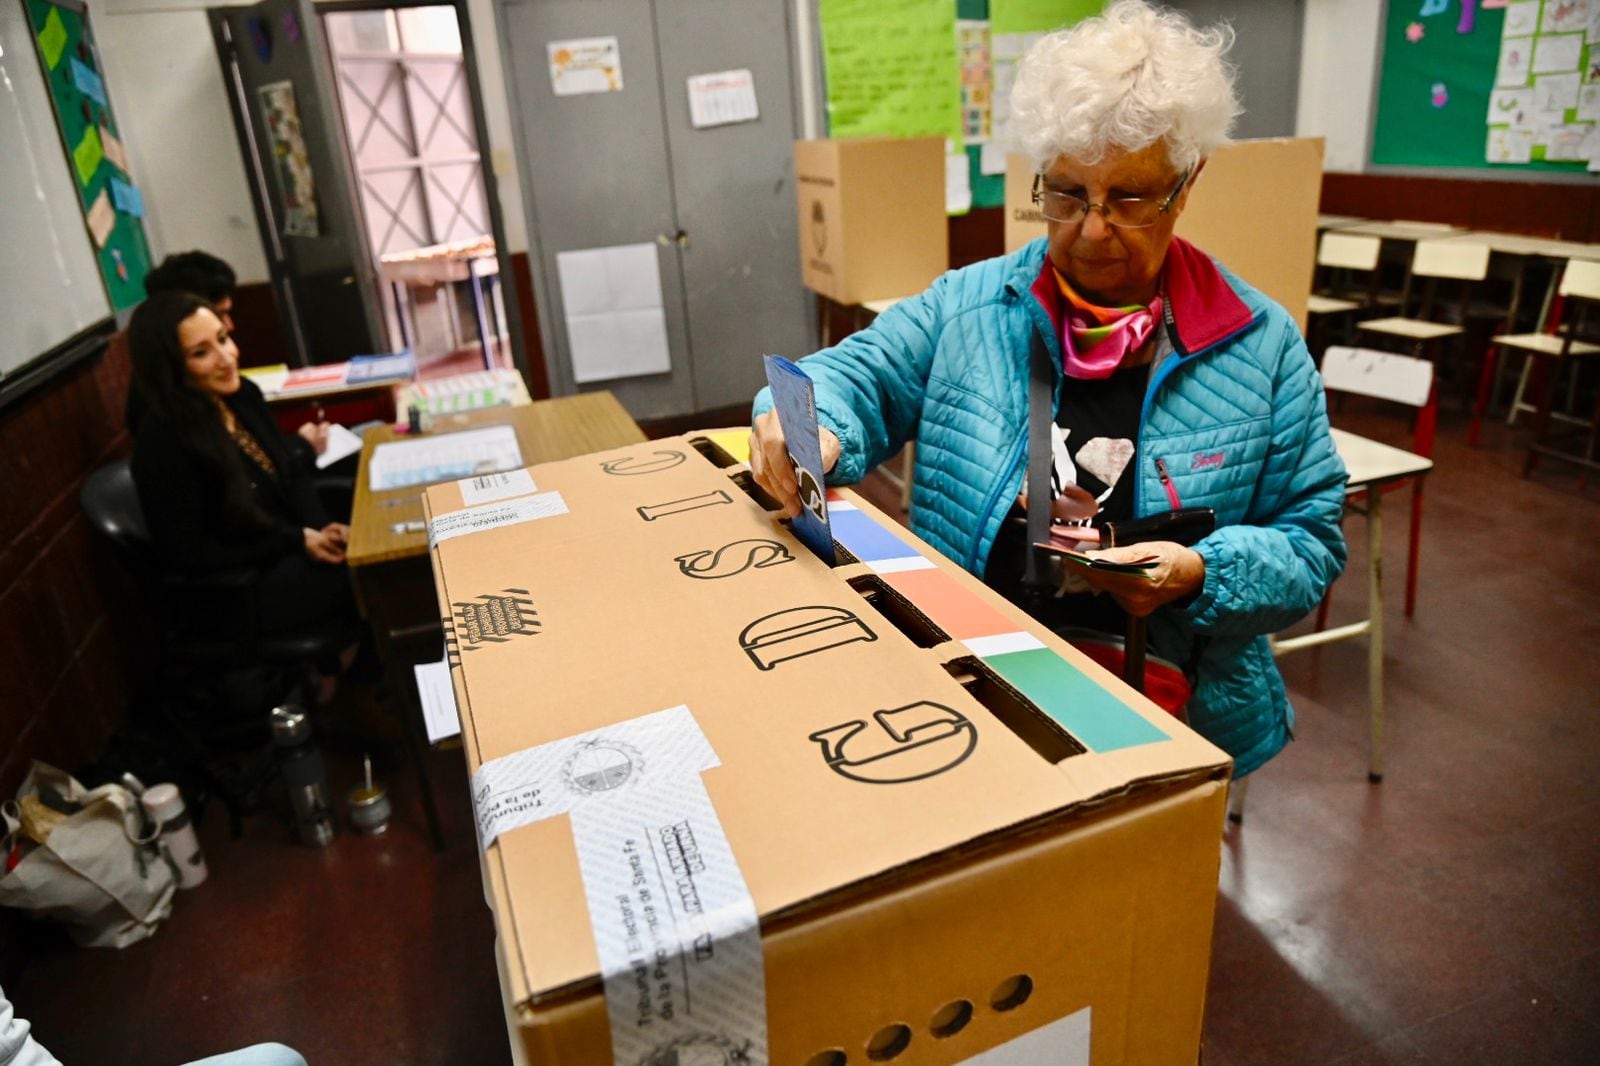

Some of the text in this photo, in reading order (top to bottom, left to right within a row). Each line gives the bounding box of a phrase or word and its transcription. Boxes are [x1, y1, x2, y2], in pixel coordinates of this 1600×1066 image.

[600, 449, 688, 476] C
[673, 538, 796, 580] S
[477, 604, 495, 635] ADHESIVA
[503, 597, 522, 631] DEFINITIVO
[467, 620, 483, 643] PEGAR
[738, 605, 878, 672] D
[808, 700, 979, 785] G
[622, 838, 637, 854] Fe
[629, 853, 647, 887] Santa
[639, 887, 652, 904] de
[615, 894, 642, 955] Electoral
